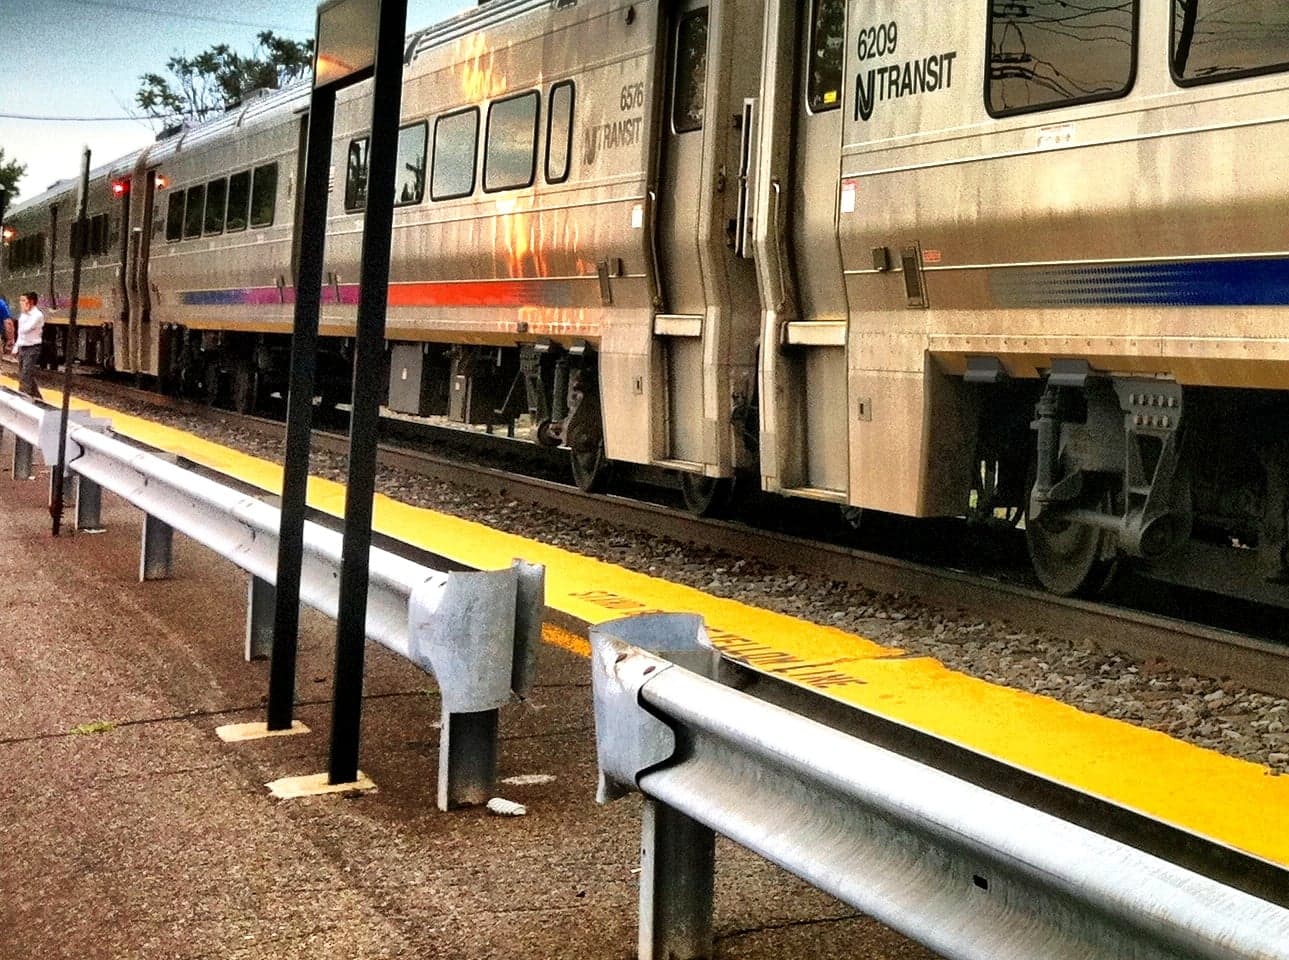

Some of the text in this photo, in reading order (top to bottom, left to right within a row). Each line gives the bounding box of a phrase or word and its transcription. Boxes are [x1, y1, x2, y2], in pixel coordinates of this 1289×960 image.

[857, 21, 897, 61] 6209
[877, 51, 956, 101] TRANSIT
[620, 82, 644, 111] 6576
[597, 117, 642, 151] TRANSIT
